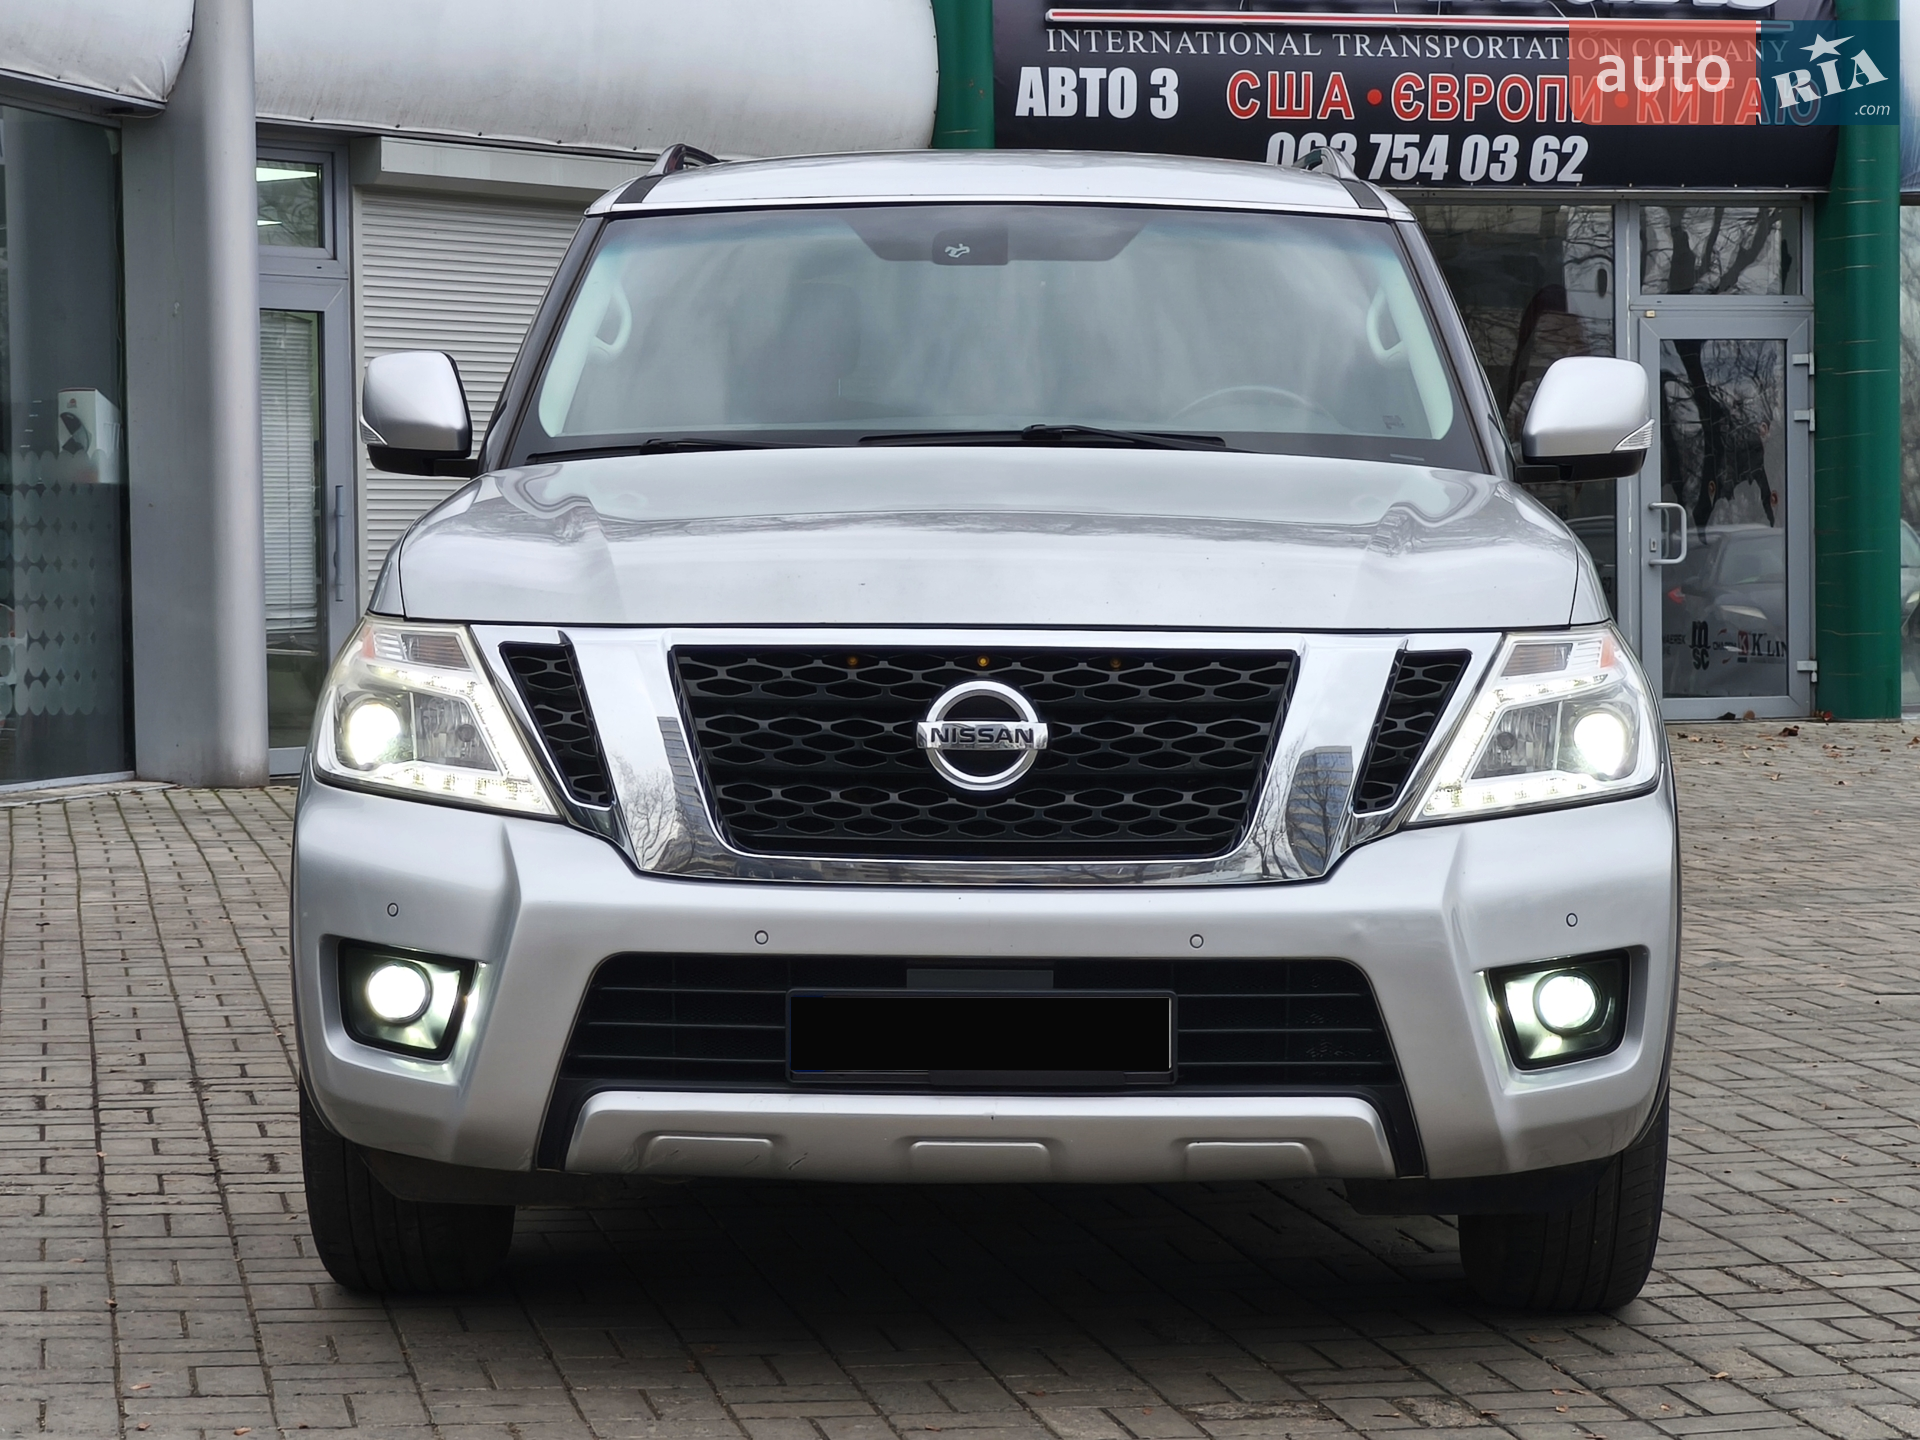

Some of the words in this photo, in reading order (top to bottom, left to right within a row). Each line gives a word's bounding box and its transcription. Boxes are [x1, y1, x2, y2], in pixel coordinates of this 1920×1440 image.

[1046, 28, 1323, 57] INTERNATIONAL
[1332, 33, 1628, 62] TRANSPORTATION
[1632, 37, 1790, 63] COMPANY
[1015, 66, 1138, 118] АВТО
[1226, 69, 1356, 120] США
[1390, 72, 1604, 124] ЄВРОПИ
[1368, 133, 1450, 181] 754
[1459, 134, 1519, 182] 03
[1528, 134, 1590, 182] 62
[930, 727, 1034, 744] NISSAN
